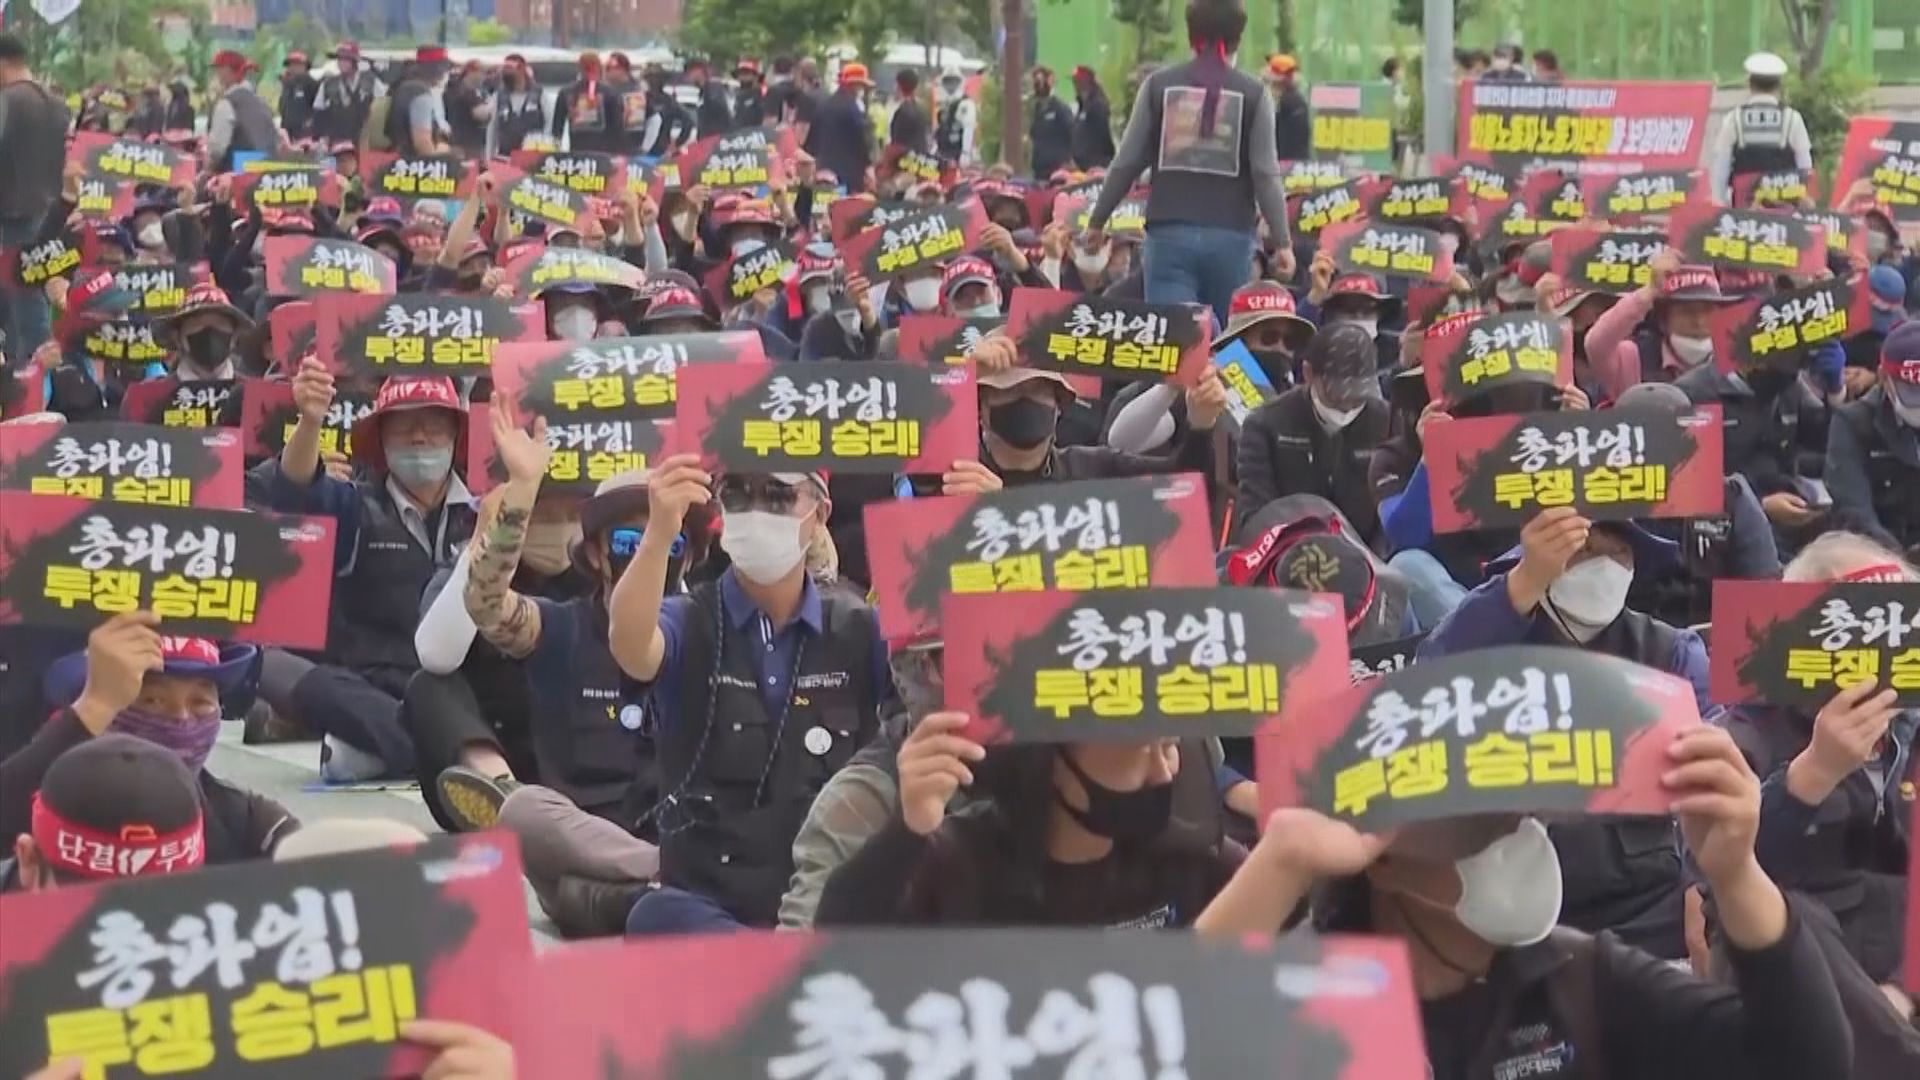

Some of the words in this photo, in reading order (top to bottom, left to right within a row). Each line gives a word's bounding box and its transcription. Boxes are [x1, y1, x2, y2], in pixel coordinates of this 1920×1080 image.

[379, 304, 483, 338] 총파업!
[1065, 304, 1167, 345] 총파업!
[366, 338, 423, 364] 투쟁
[568, 344, 688, 378] 총파업!
[1048, 334, 1107, 365] 투쟁
[1112, 342, 1180, 374] 승리!
[554, 375, 625, 410] 투쟁
[760, 376, 897, 421] 총파업!
[47, 438, 172, 477] 총파업!
[743, 420, 821, 456] 투쟁
[831, 420, 920, 457] 승리!
[1510, 424, 1645, 473] 총파업!
[112, 477, 190, 507] 승리!
[1495, 468, 1574, 509] 투쟁
[1584, 465, 1666, 503] 승리!
[69, 515, 236, 578] 총파업!
[965, 497, 1121, 562] 총파업!
[1054, 545, 1150, 590] 승리!
[44, 566, 141, 614] 투쟁
[152, 574, 258, 624] 승리!
[1057, 607, 1246, 669] 총파업!
[1809, 598, 1920, 651] 총파
[1786, 648, 1879, 689] 투쟁
[1035, 666, 1143, 719] 투쟁
[1157, 664, 1279, 713] 승리!
[1356, 667, 1573, 759] 총파업!
[1333, 739, 1448, 816] 투쟁
[1465, 729, 1614, 788] 승리!
[58, 830, 114, 873] 단결
[157, 831, 199, 872] 투쟁
[77, 888, 363, 1010] 총파업!
[46, 993, 215, 1080] 투쟁
[231, 963, 416, 1060] 승리!
